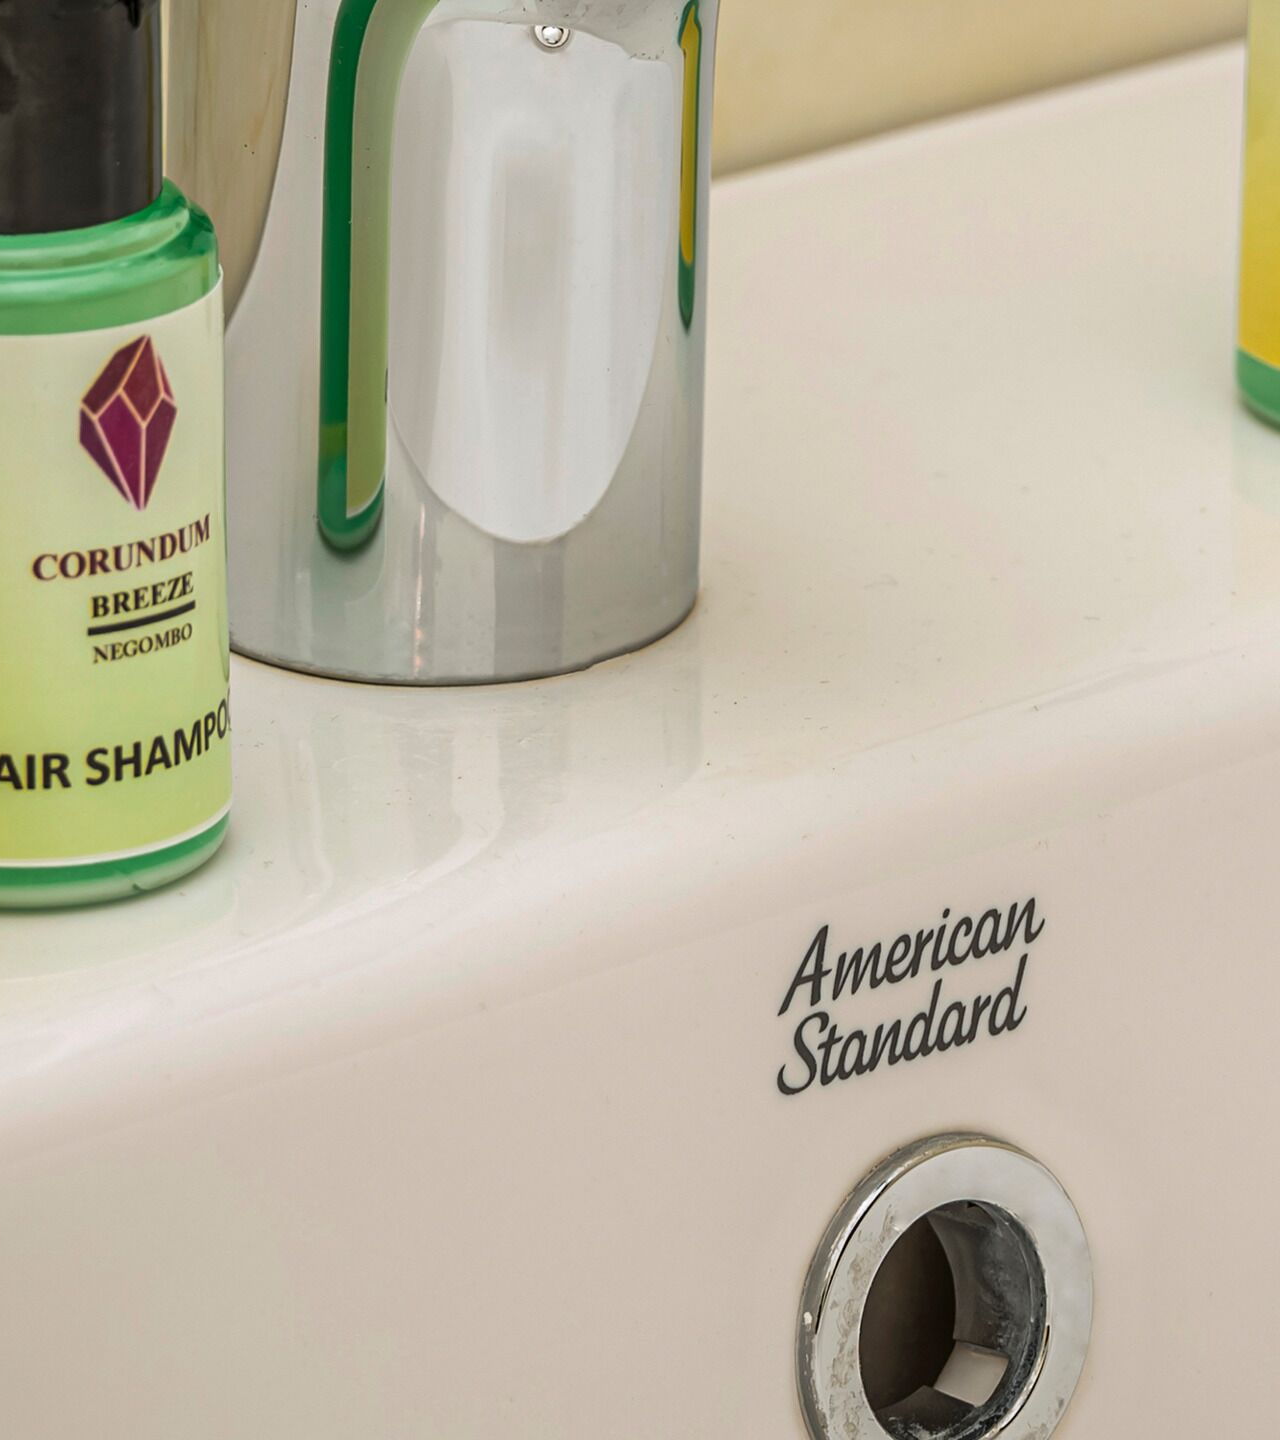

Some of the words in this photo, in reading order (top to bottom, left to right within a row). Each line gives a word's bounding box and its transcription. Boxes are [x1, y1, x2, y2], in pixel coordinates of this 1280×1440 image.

[32, 514, 212, 583] CORUNDUM
[90, 571, 194, 620] BREEZE
[92, 622, 194, 666] NEGOMBO
[777, 896, 1046, 1017] American
[776, 952, 1029, 1096] Standard
